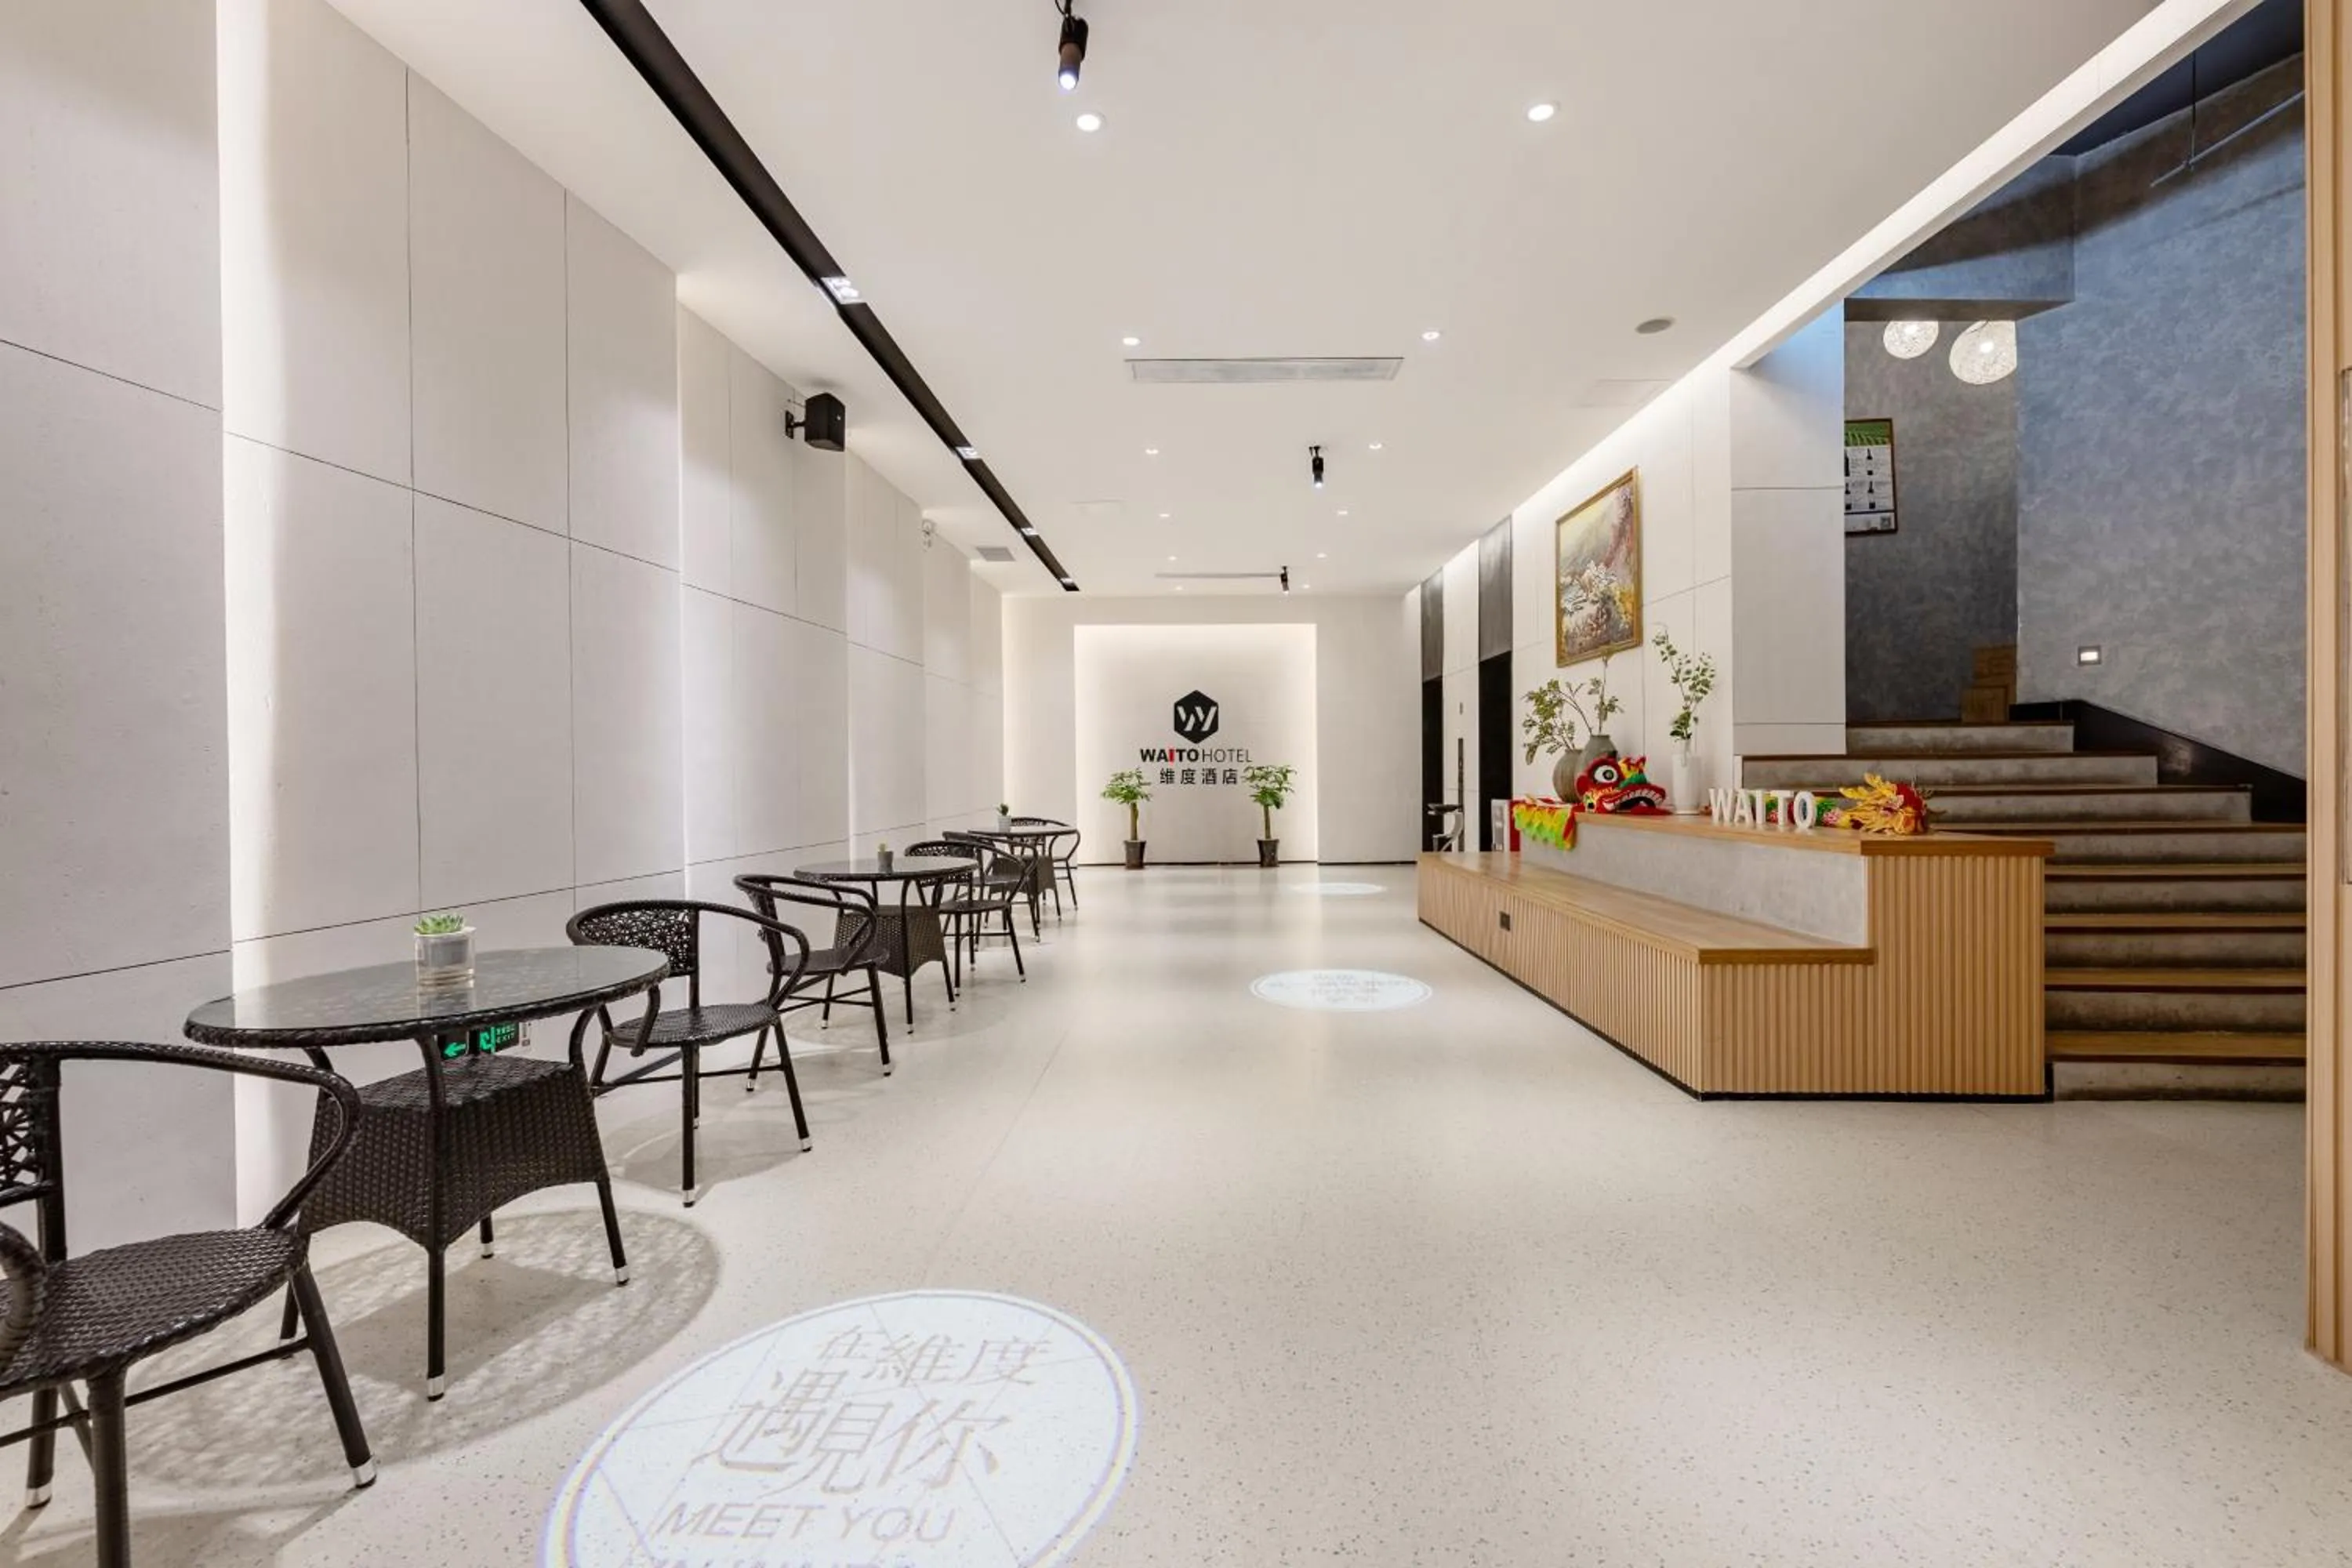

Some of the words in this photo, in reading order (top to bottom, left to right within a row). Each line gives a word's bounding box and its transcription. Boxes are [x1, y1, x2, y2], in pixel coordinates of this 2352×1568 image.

[1140, 749, 1199, 763] WAITO
[1202, 749, 1253, 763] HOTEL
[1160, 768, 1238, 785] 维度酒店
[1709, 788, 1817, 829] WAITO
[690, 1368, 1012, 1499] 遇見你
[655, 1501, 826, 1539] MEET
[840, 1505, 956, 1542] YOU
